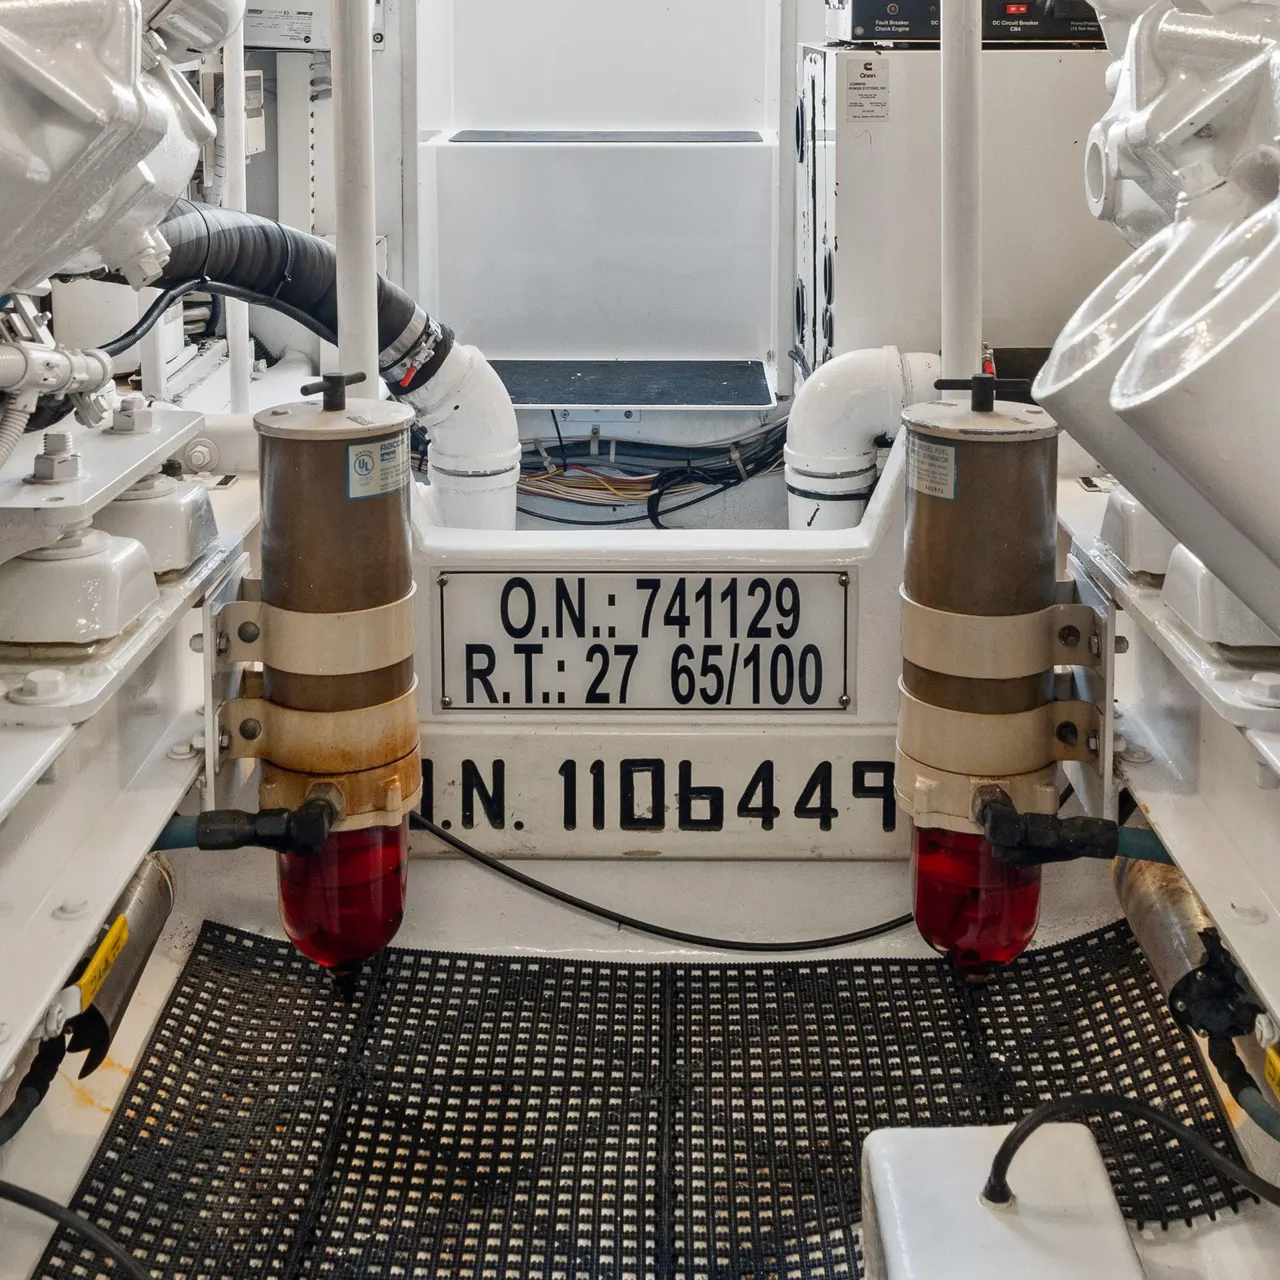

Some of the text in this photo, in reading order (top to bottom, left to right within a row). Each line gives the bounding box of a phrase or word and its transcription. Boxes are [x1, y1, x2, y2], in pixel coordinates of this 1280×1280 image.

[358, 458, 371, 472] UL
[500, 577, 801, 640] O.N.: 741129
[465, 642, 823, 706] R.T.: 27 65/100
[410, 758, 525, 832] .N.
